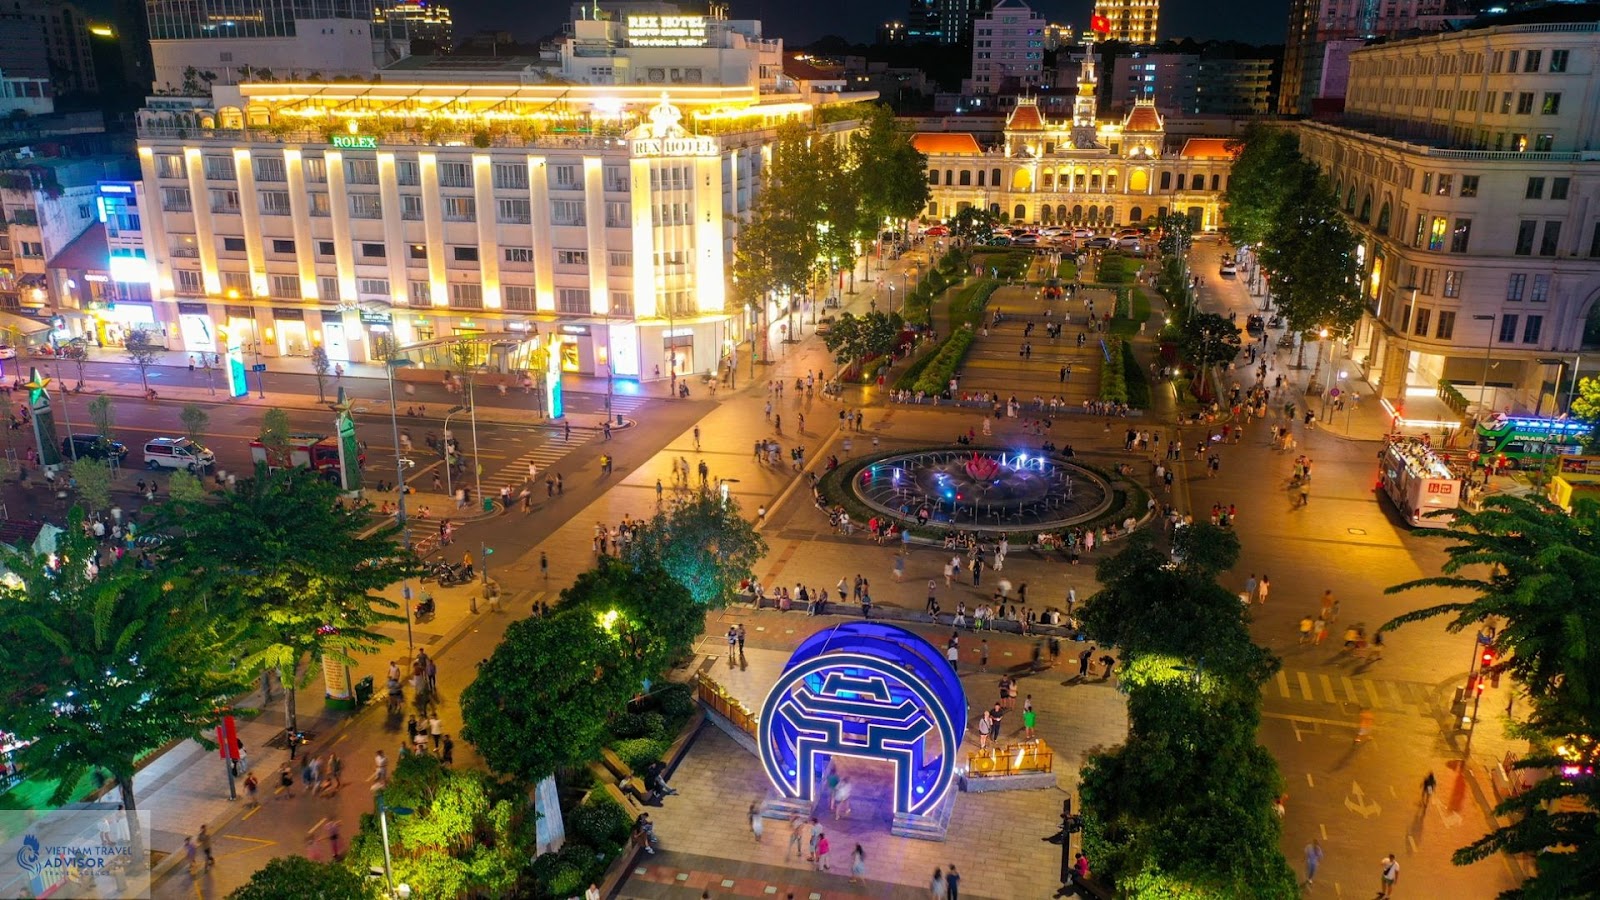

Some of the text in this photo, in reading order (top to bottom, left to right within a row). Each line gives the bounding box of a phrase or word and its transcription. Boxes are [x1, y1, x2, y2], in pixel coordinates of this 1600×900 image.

[628, 16, 706, 28] REX HOTEL
[333, 136, 377, 148] ROLEX
[635, 141, 715, 154] REX HOTEL
